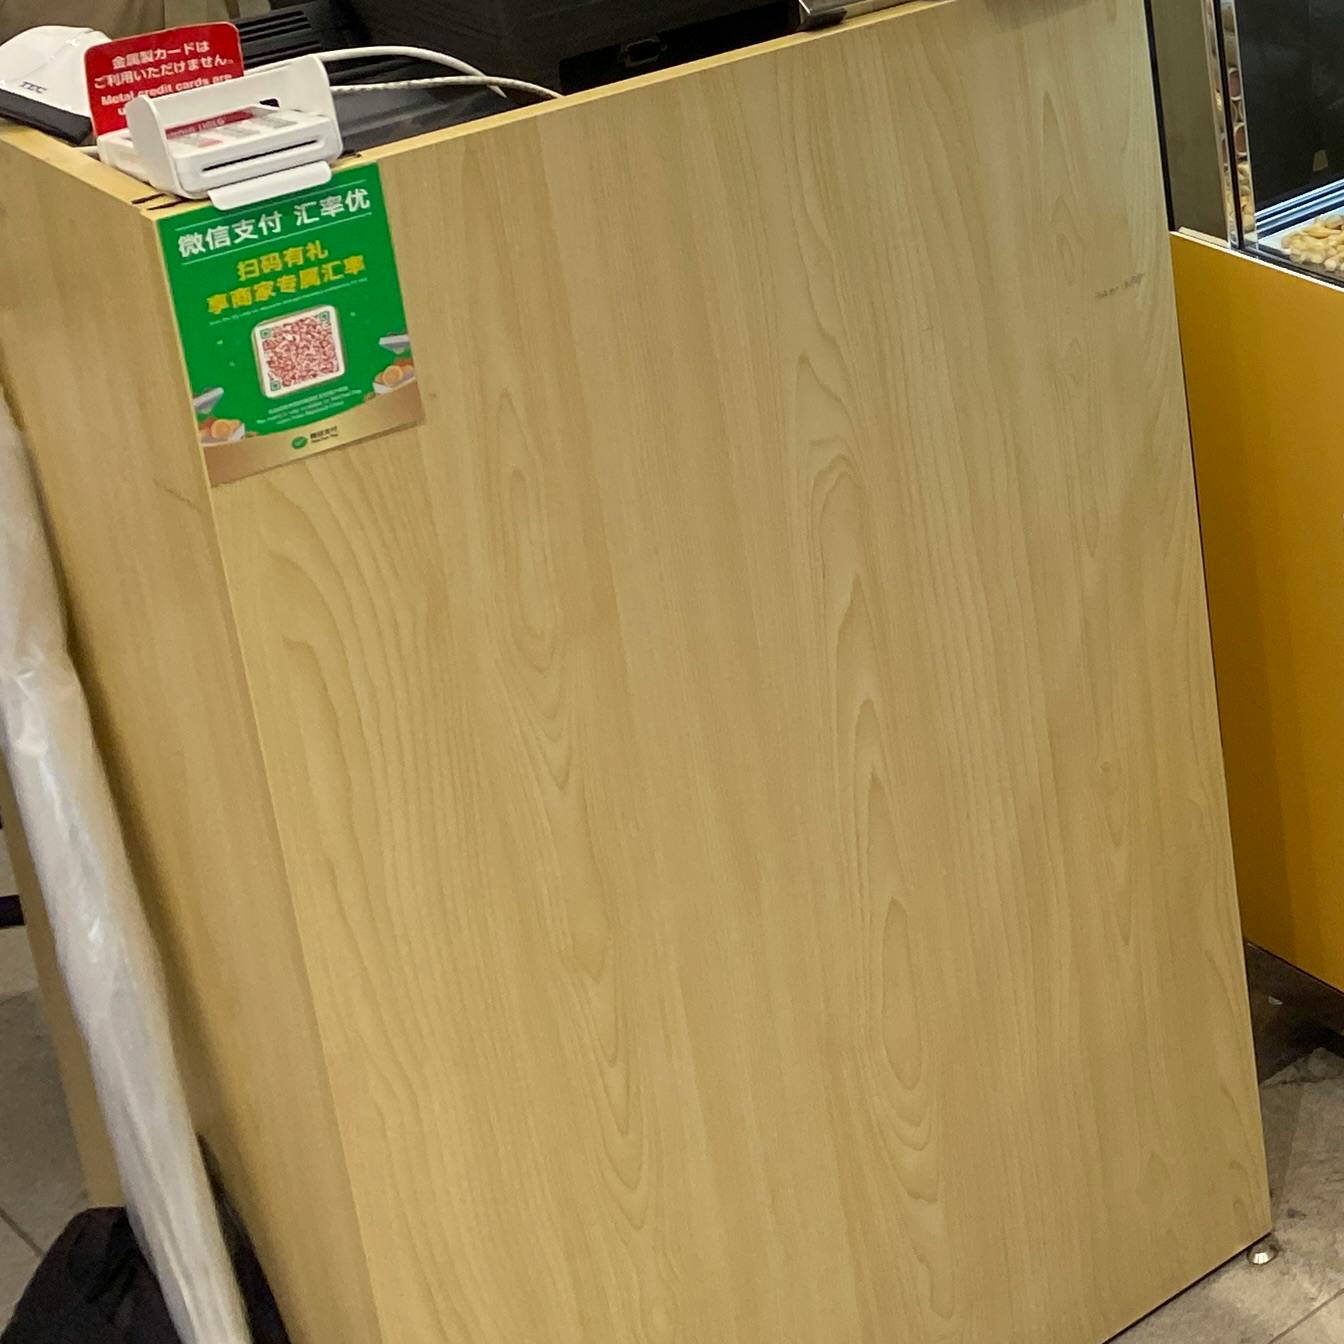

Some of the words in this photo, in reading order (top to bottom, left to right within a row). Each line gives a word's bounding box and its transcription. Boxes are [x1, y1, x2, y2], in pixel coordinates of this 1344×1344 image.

[112, 40, 210, 70] 金属製カードは
[19, 81, 48, 94] TEC
[101, 91, 135, 106] Metal
[175, 77, 210, 92] cards
[178, 210, 283, 258] 微信支付
[293, 187, 371, 227] 汇率优
[237, 239, 328, 282] 扫码有礼
[207, 255, 366, 315] 享商家专属汇率
